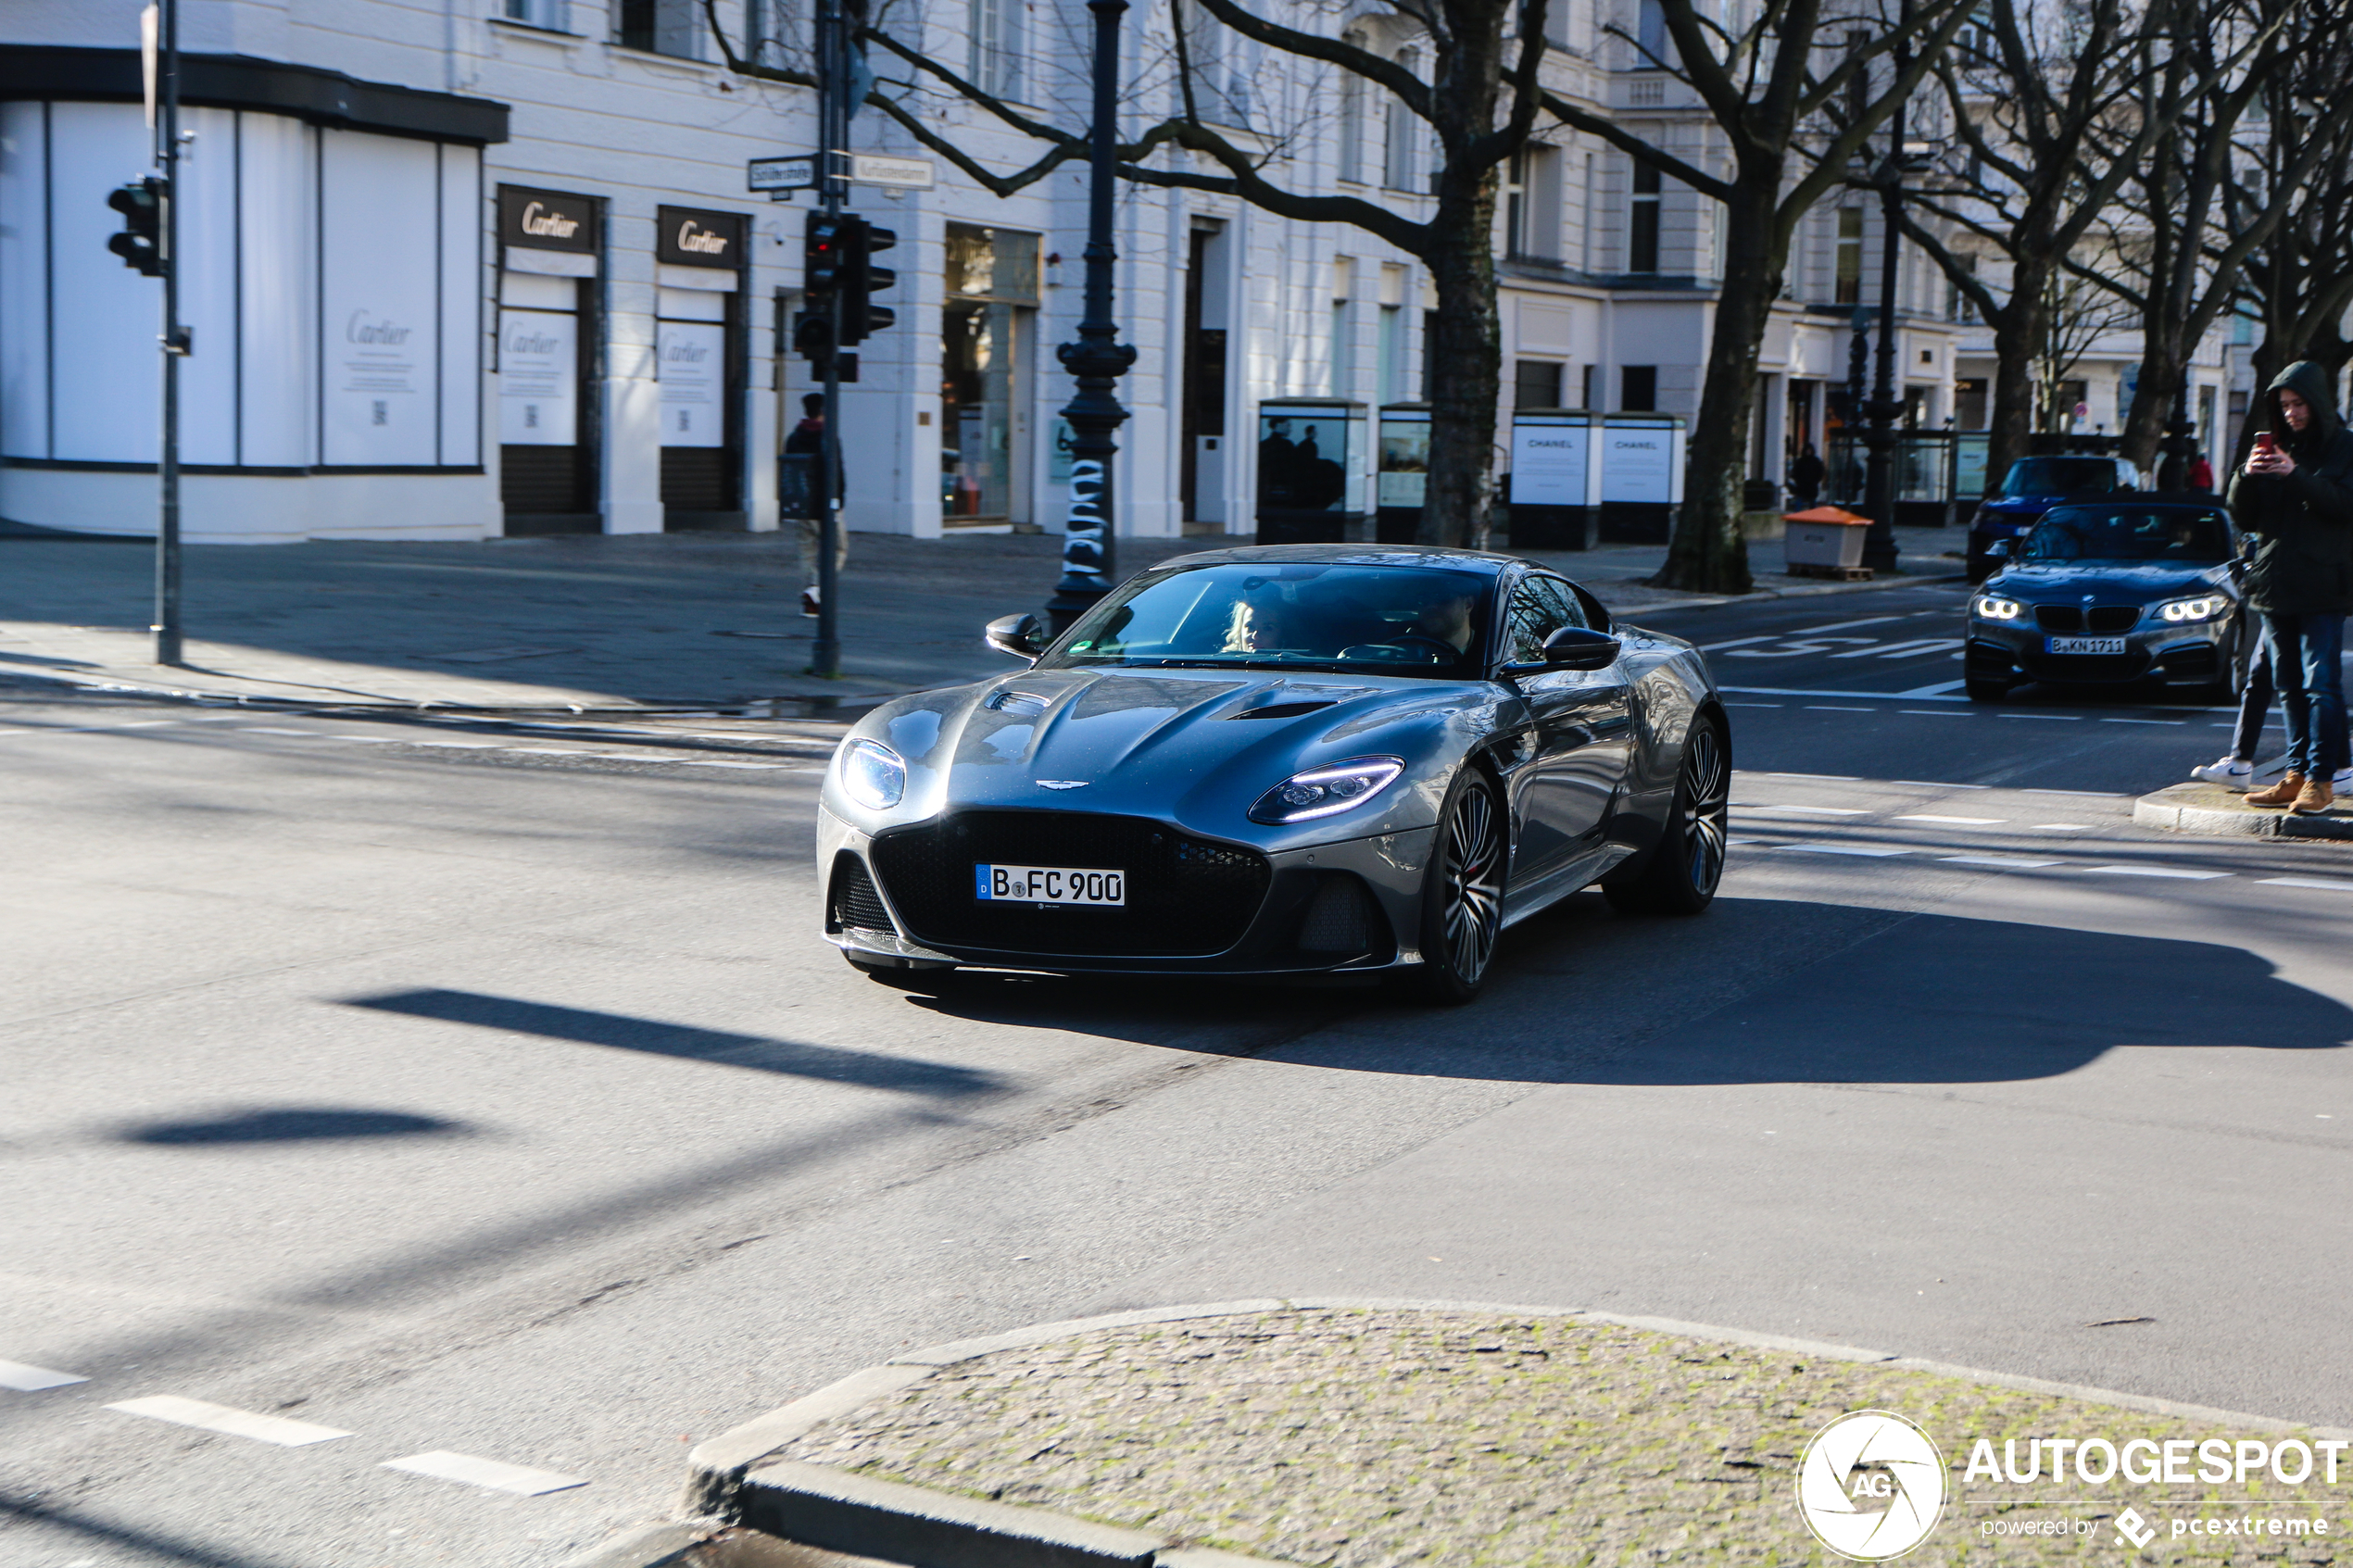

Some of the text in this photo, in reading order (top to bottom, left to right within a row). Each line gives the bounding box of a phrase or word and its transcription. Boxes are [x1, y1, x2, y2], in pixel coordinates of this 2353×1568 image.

[522, 201, 579, 238] Cartier
[677, 220, 728, 254] Cartier
[346, 308, 413, 345] Cartier
[501, 320, 560, 355] Cartier
[660, 331, 711, 363] Cartier
[1528, 439, 1573, 449] CHANEL
[1615, 441, 1657, 450] CHANEL
[993, 869, 1122, 901] B FC 900
